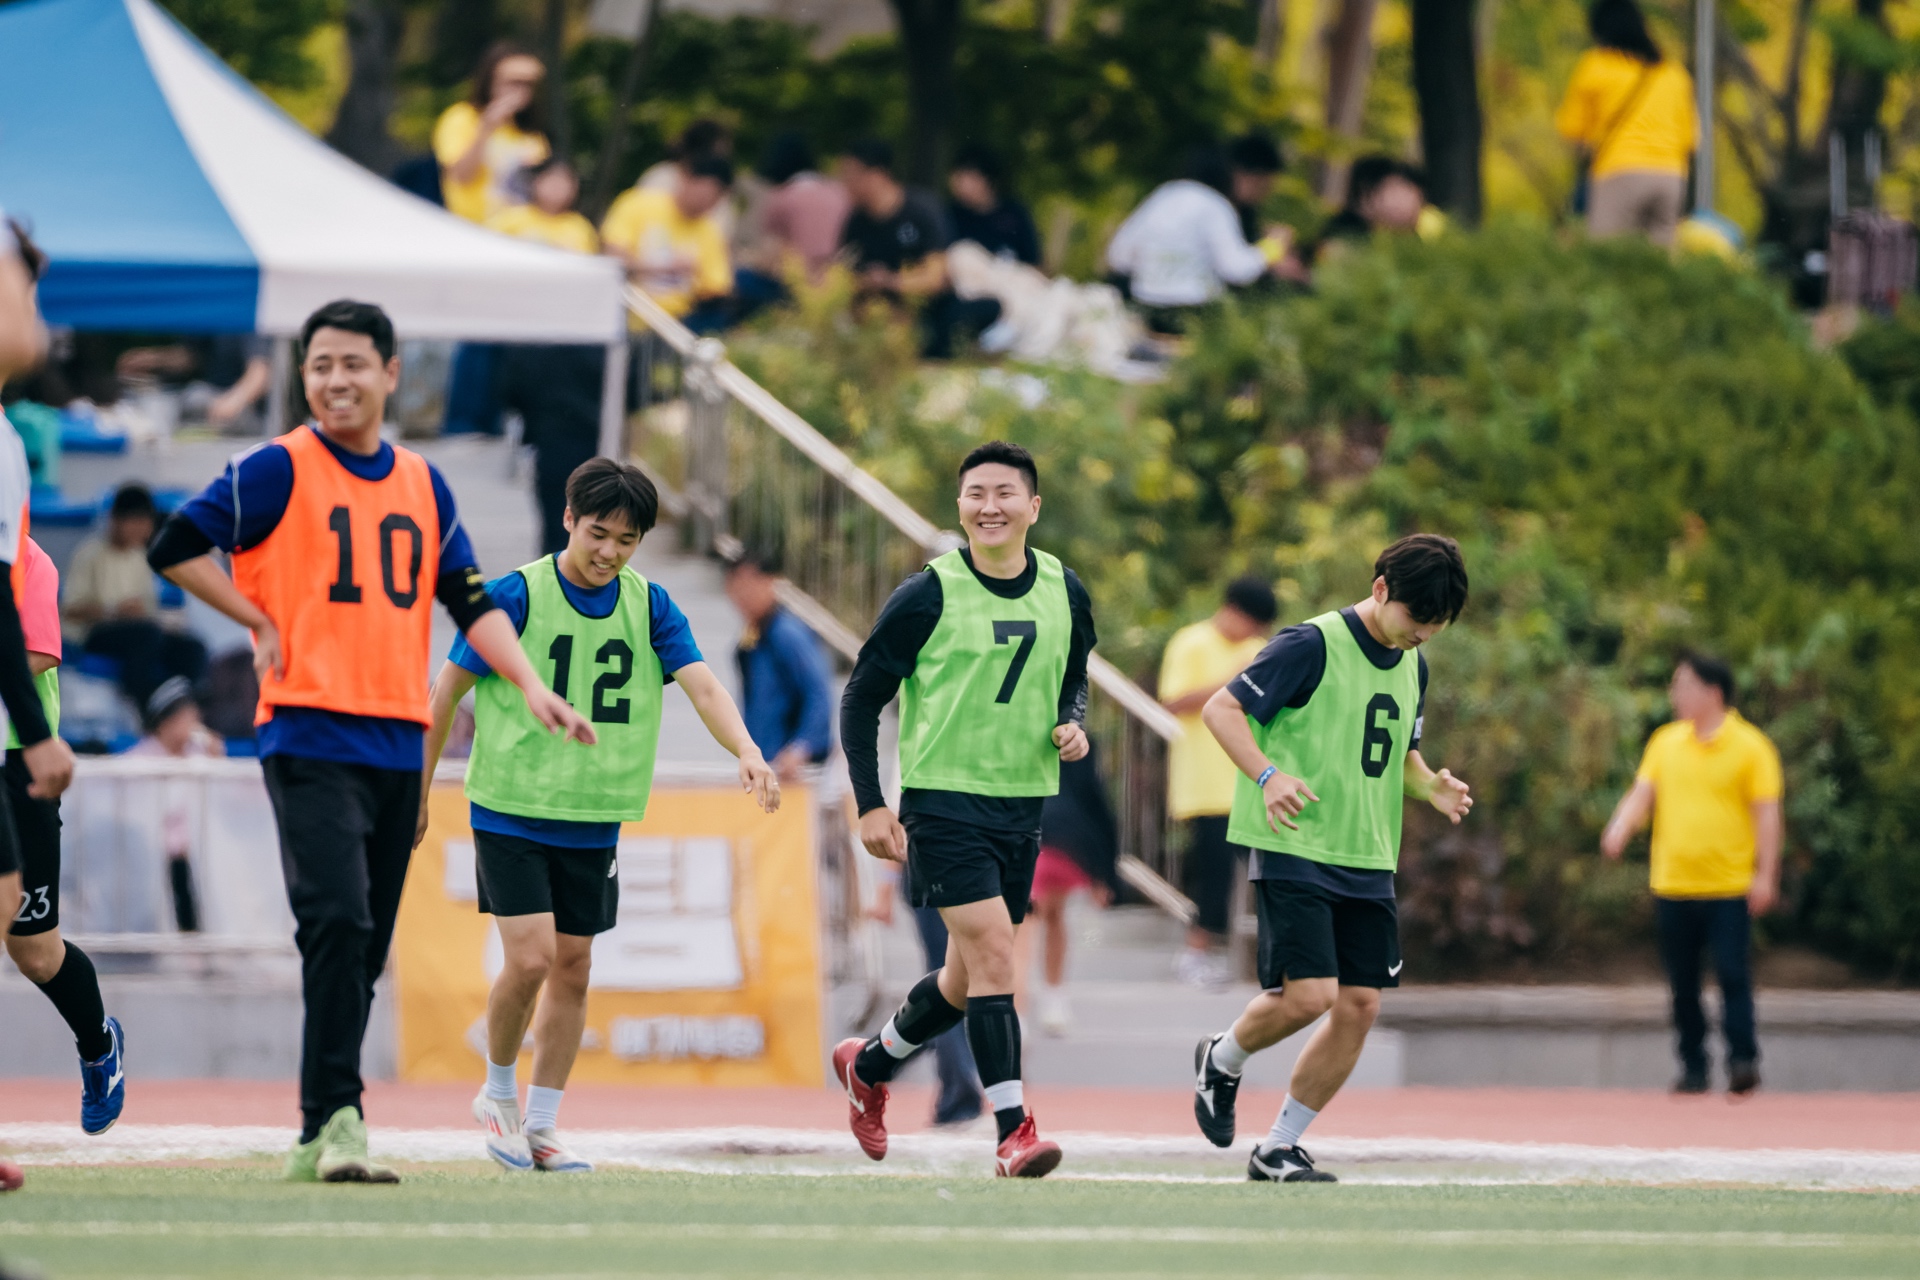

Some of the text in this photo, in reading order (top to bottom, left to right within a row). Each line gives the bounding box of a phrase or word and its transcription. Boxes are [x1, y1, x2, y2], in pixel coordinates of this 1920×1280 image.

[329, 506, 423, 609] 10
[548, 634, 634, 724] 12
[991, 620, 1038, 705] 7
[1360, 692, 1400, 779] 6
[13, 885, 51, 922] 23
